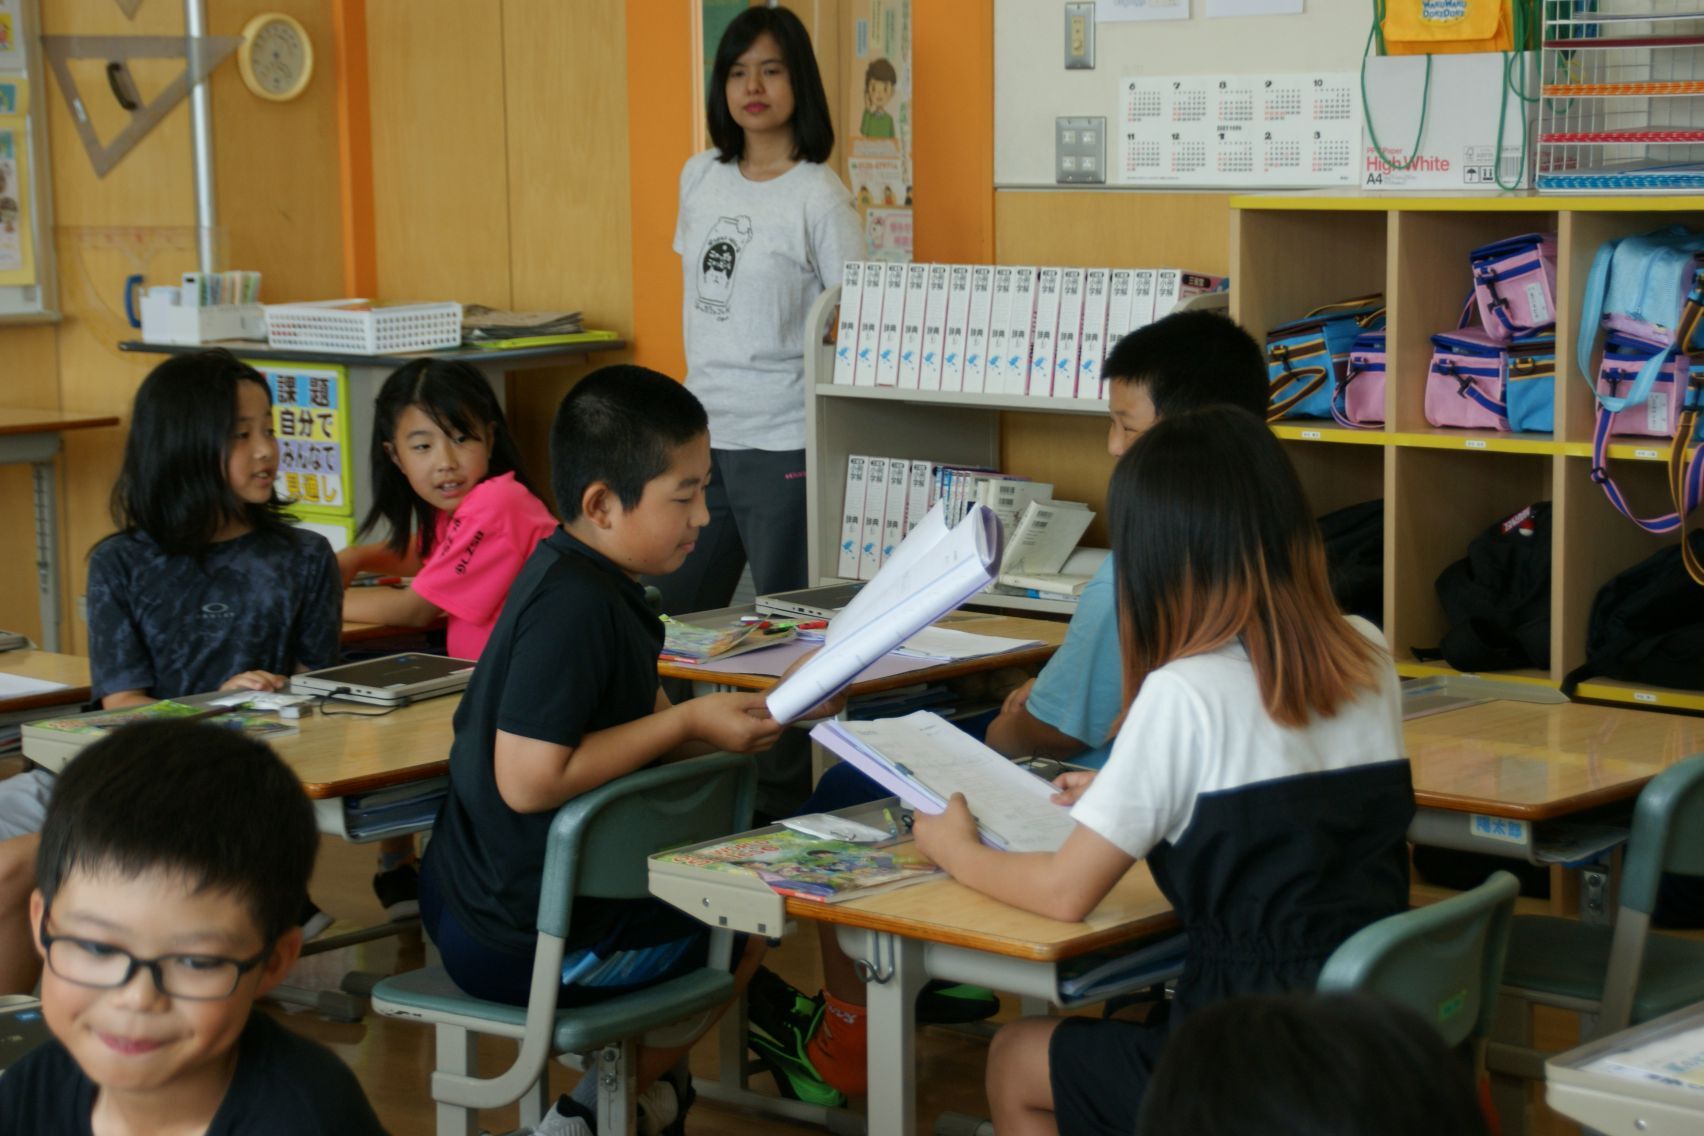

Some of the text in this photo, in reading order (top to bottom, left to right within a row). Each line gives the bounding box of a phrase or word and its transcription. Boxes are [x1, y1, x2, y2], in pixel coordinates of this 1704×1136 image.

[1129, 79, 1323, 91] 6 7 8 9 10
[1127, 133, 1135, 141] 11
[1264, 131, 1272, 140] 2
[1314, 131, 1321, 139] 3
[1366, 155, 1402, 175] High
[1403, 155, 1450, 172] White
[1366, 172, 1383, 185] A4
[277, 375, 330, 407] 課題
[280, 409, 334, 438] 自分で
